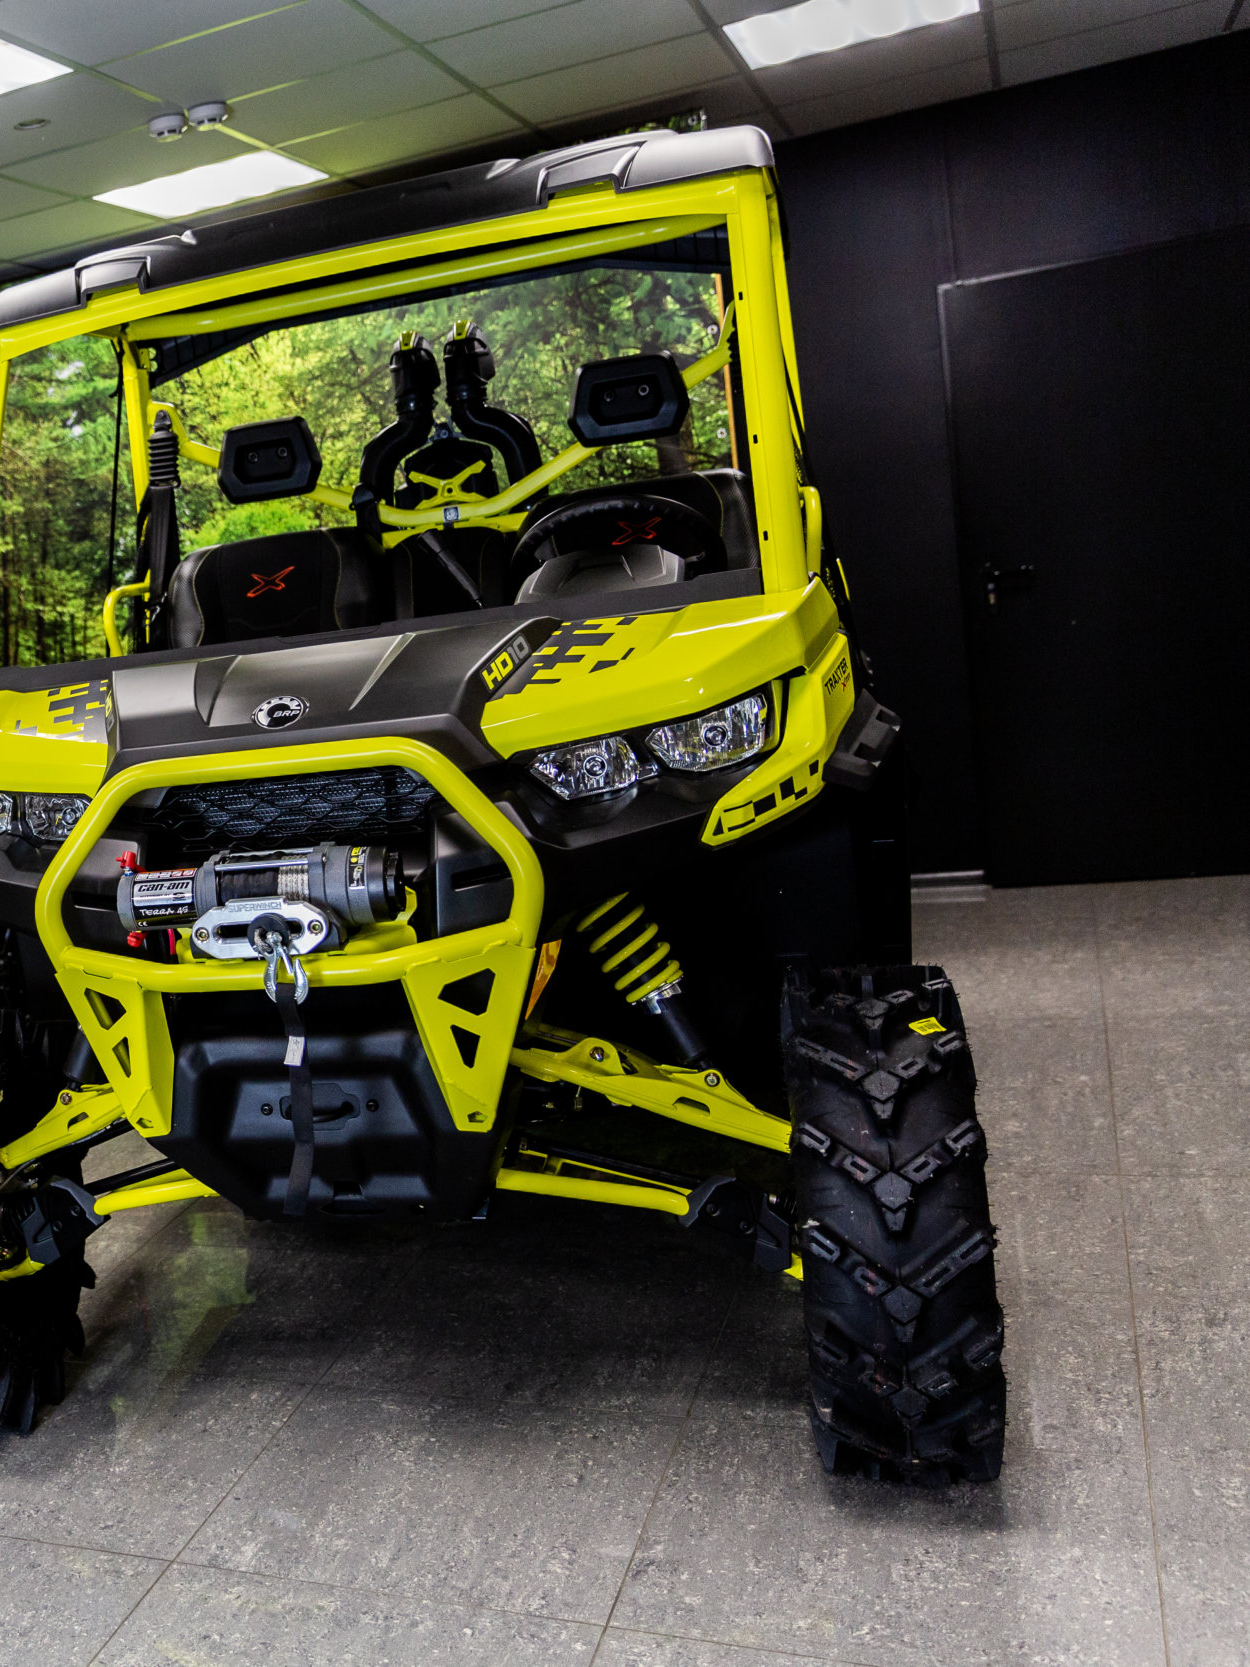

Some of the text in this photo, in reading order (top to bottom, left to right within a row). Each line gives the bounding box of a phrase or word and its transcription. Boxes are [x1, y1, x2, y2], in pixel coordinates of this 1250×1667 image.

[481, 635, 529, 690] HD10
[824, 656, 849, 695] TRAXTER
[272, 709, 300, 718] BRP
[139, 907, 175, 917] TERRA
